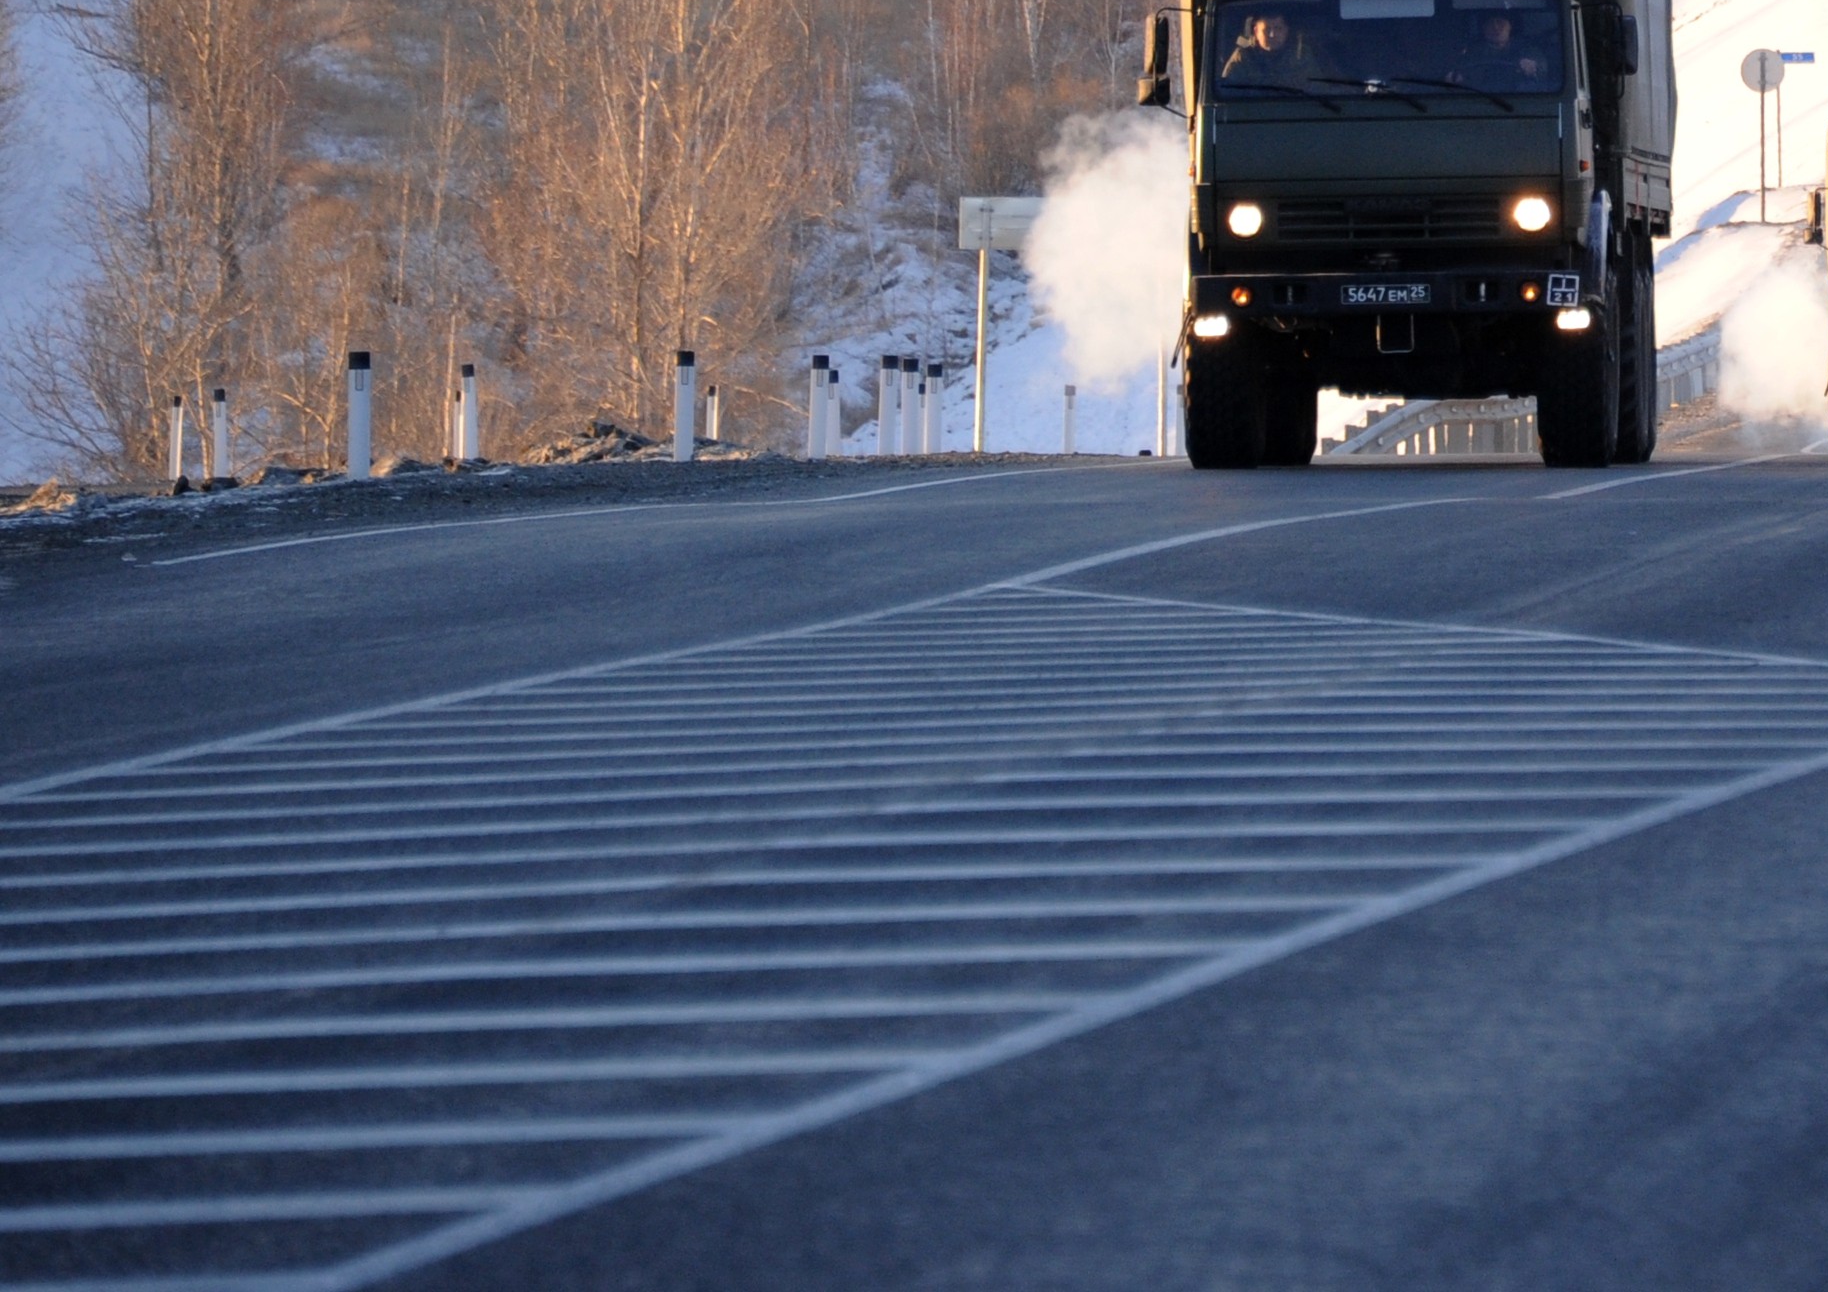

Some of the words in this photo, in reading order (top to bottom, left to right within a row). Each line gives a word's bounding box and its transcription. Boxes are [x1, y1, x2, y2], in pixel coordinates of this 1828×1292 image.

[1348, 287, 1386, 302] 5647
[1388, 290, 1408, 302] ЕМ
[1410, 286, 1426, 298] 25
